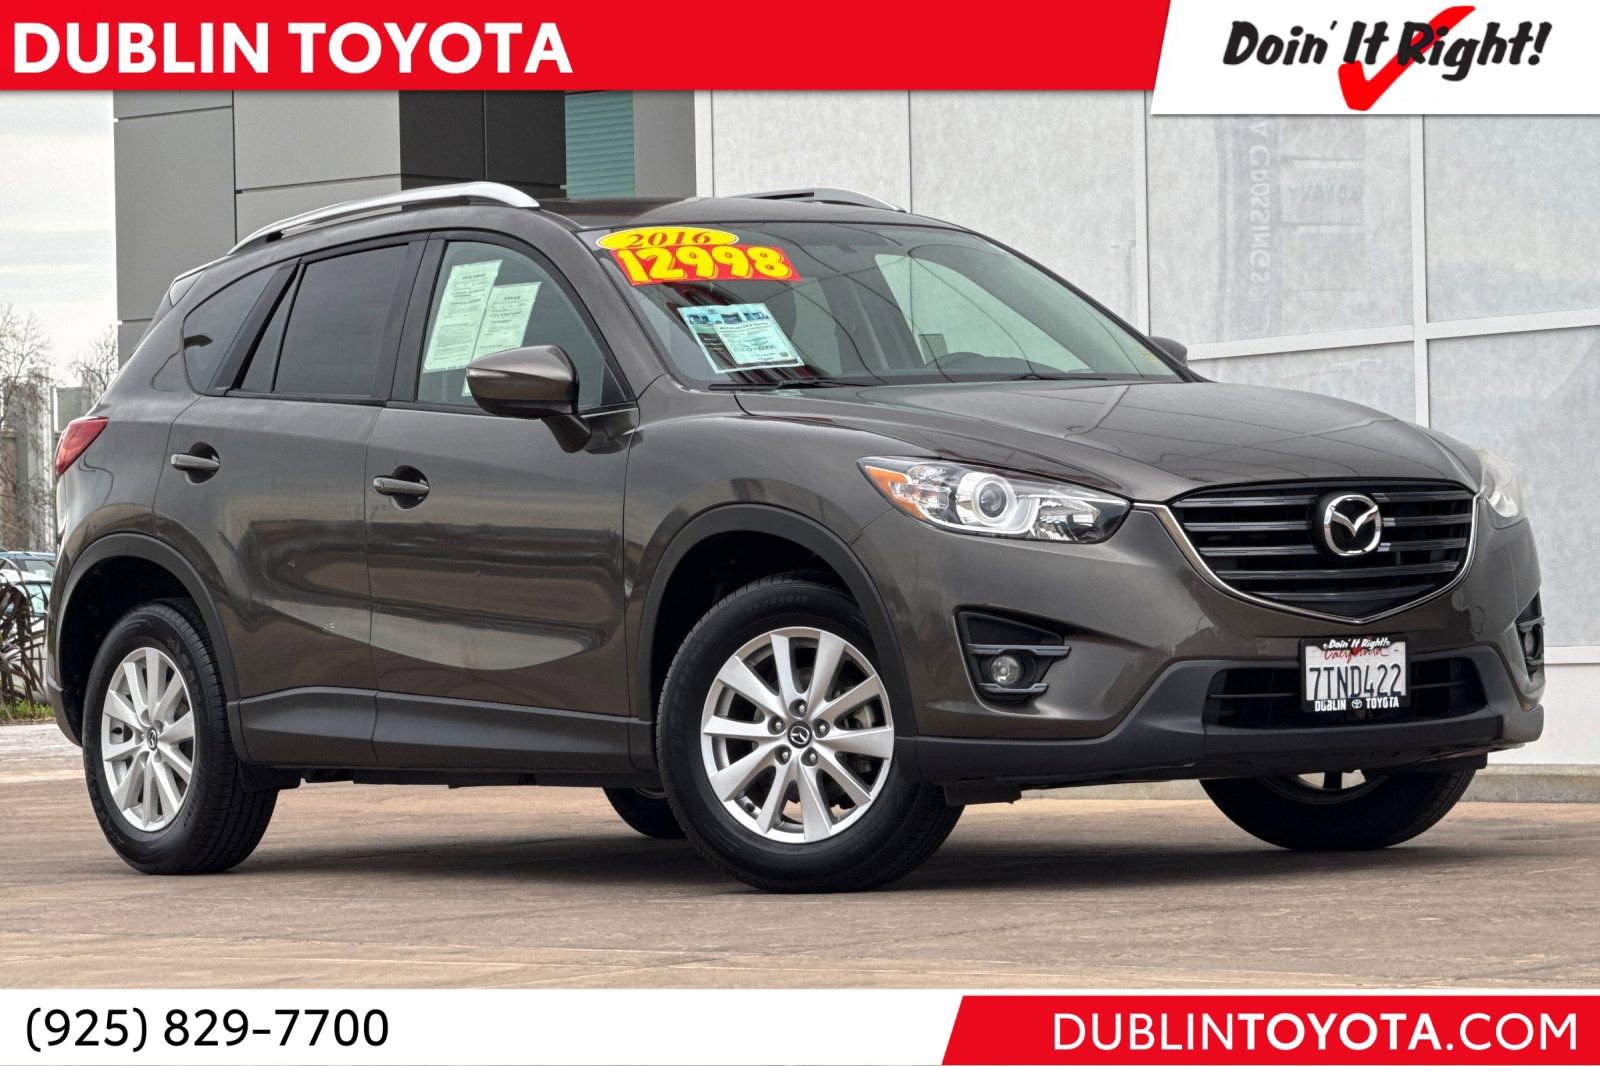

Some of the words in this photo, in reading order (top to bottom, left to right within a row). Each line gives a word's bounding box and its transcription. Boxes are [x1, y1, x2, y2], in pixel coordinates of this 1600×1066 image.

[624, 231, 712, 249] 2016
[617, 245, 794, 283] 12998
[1351, 638, 1361, 647] It
[1324, 647, 1390, 664] Califrnia
[1308, 663, 1402, 700] 7TND422
[1314, 699, 1347, 712] DUBLIN
[1366, 696, 1400, 710] TOYOTA
